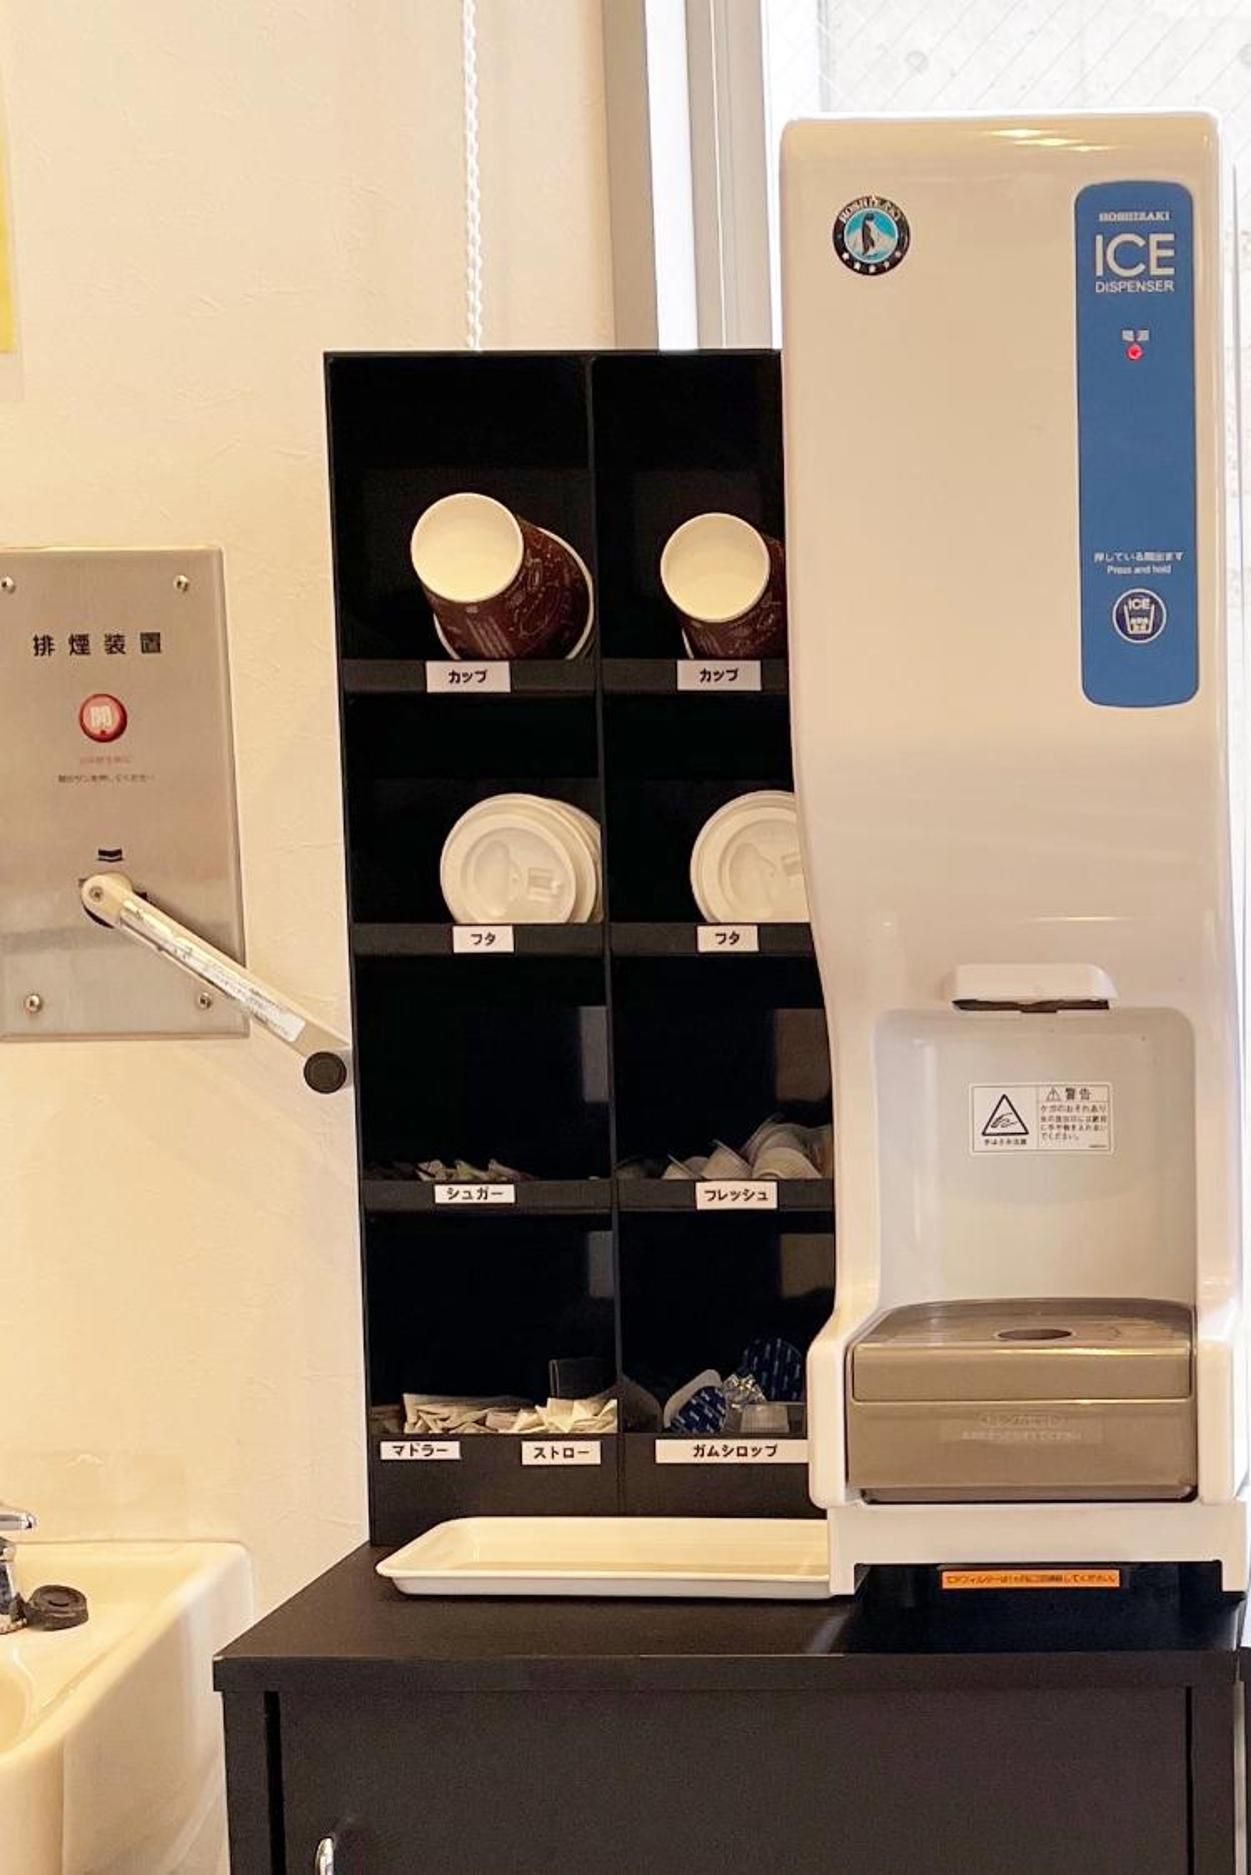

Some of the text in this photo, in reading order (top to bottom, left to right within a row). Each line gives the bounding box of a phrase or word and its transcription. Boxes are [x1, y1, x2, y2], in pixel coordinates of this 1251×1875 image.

[1095, 232, 1175, 277] ICE
[1095, 279, 1175, 294] DISPENSER
[1107, 564, 1171, 575] Press and hold
[1128, 598, 1150, 610] ICE
[32, 631, 162, 657] 排煙装置
[448, 669, 488, 684] カップ
[699, 667, 739, 683] カップ
[470, 932, 496, 946] フタ
[715, 931, 741, 946] フタ
[447, 1187, 504, 1201] シュガー
[704, 1188, 769, 1202] フレッシュ
[392, 1443, 449, 1457] マドラー
[533, 1446, 590, 1460] ストロー
[693, 1443, 778, 1459] ガムシロップ
